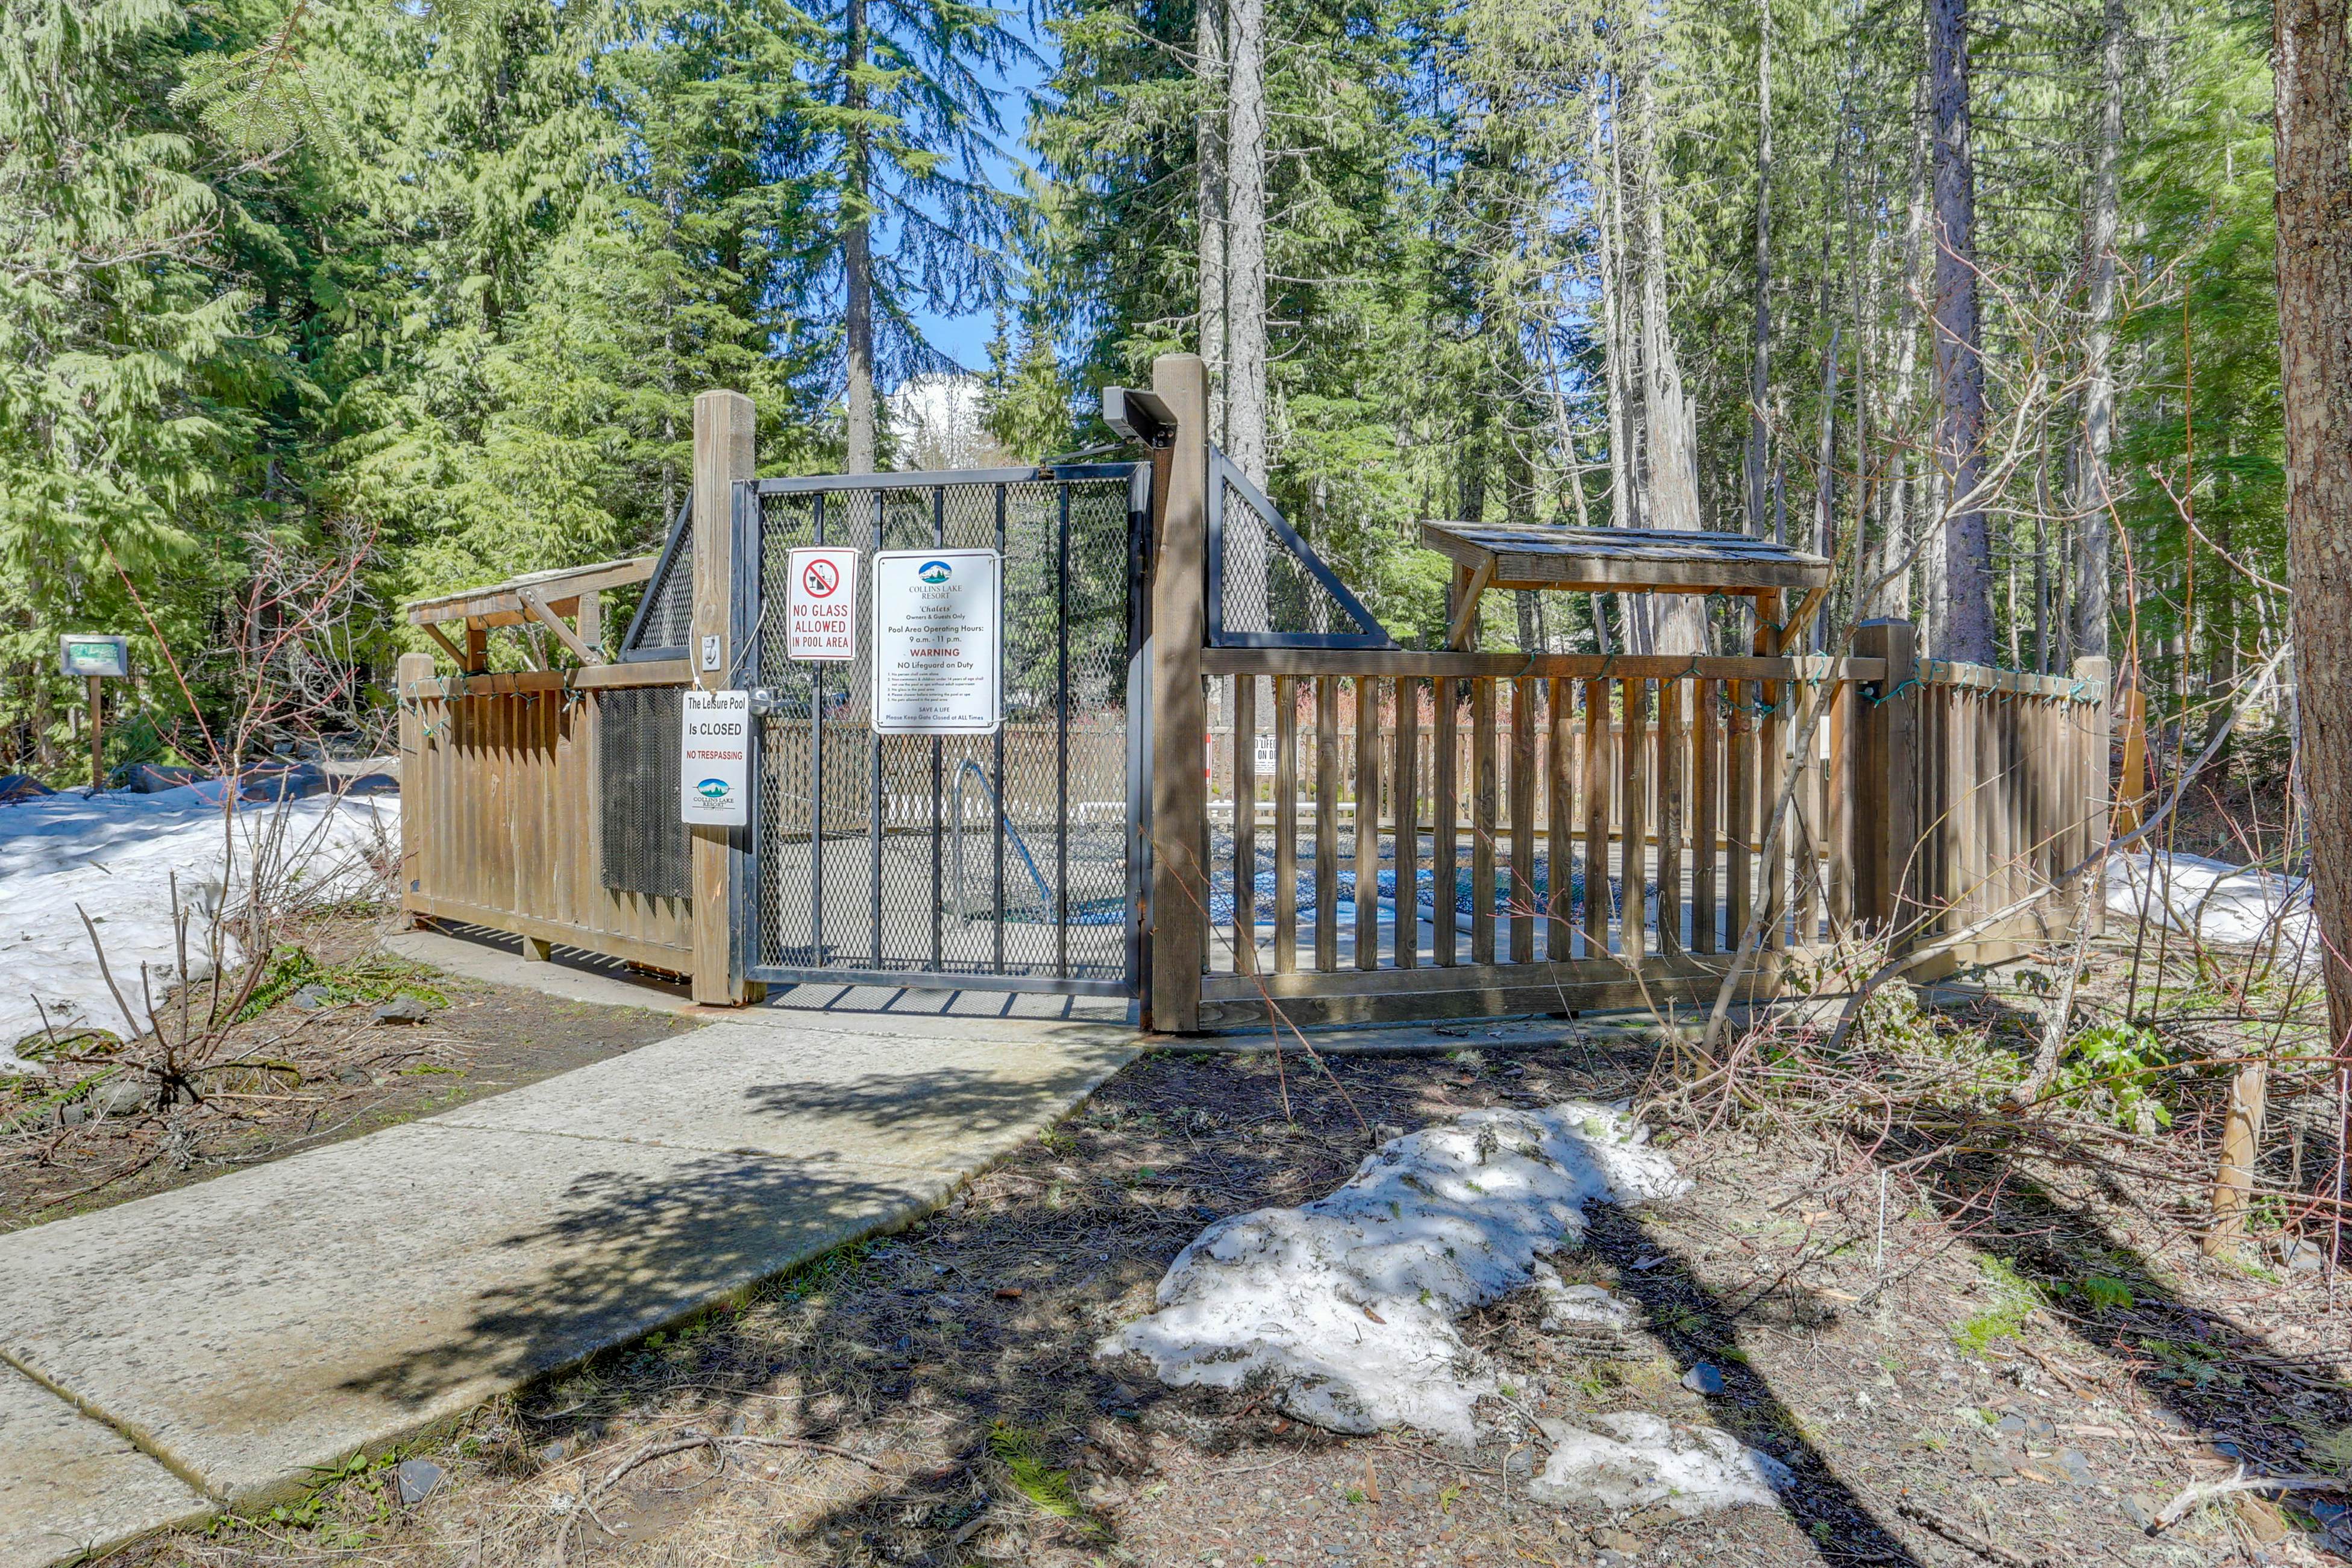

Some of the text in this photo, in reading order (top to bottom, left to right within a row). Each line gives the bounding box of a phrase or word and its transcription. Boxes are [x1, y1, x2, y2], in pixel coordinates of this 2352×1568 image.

[794, 604, 848, 616] NO GLASS
[795, 621, 845, 633] ALLOWED
[923, 626, 959, 634] Operating
[792, 636, 848, 647] IN POOL AREA
[912, 662, 944, 670] Lifeguard
[688, 697, 745, 709] The Leisure Pool
[689, 723, 741, 735] Is CLOSED
[686, 751, 742, 760] NO TRESPASSING
